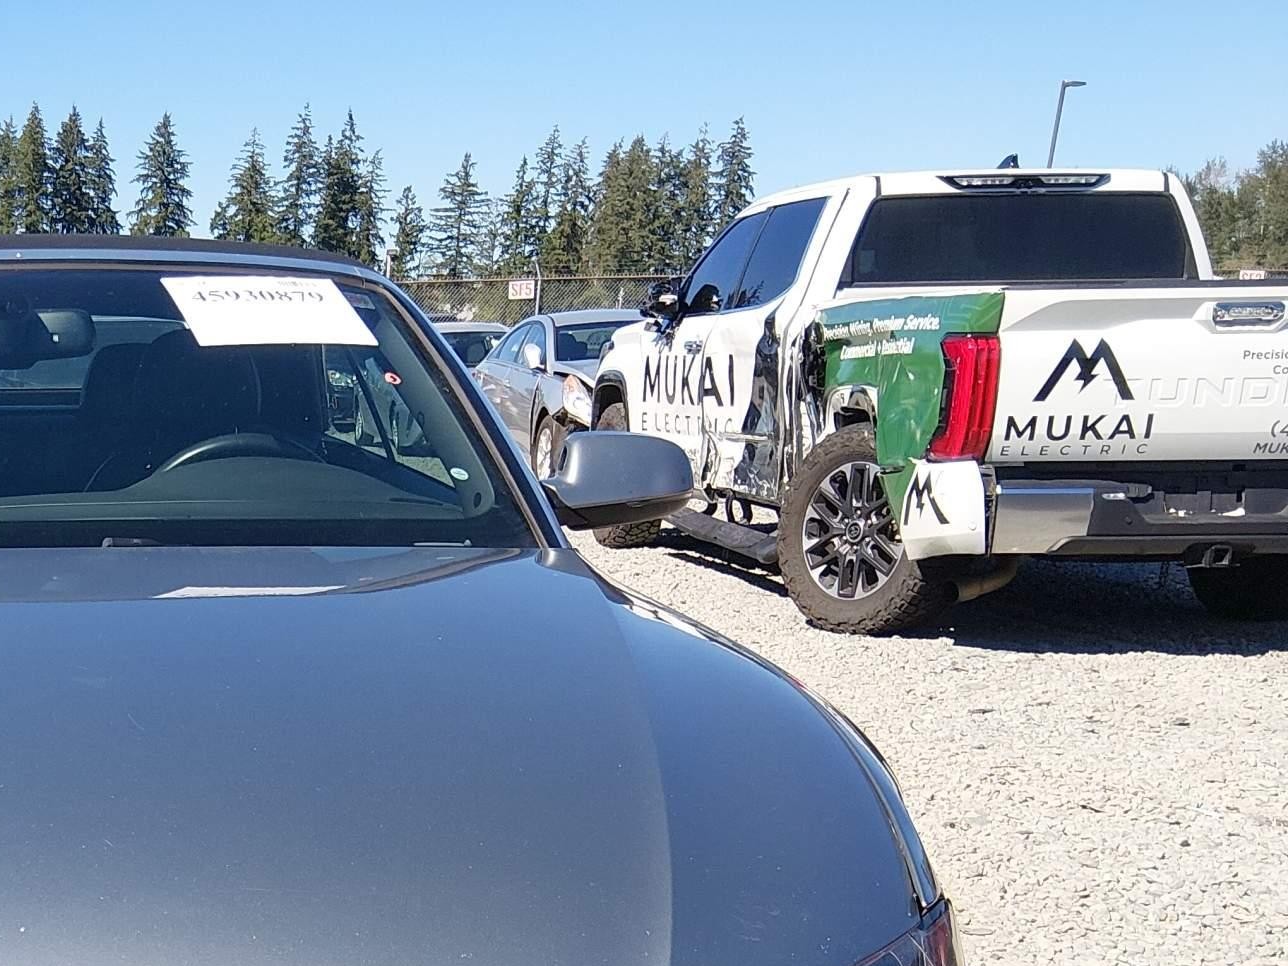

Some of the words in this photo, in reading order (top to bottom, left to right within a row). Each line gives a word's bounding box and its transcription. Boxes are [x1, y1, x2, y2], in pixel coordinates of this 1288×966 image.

[191, 288, 325, 303] 45930879
[511, 282, 533, 297] SF5
[904, 313, 941, 331] Service.
[642, 354, 734, 407] MUKAI
[1003, 413, 1154, 441] MUKAI
[999, 443, 1148, 456] ELECTRIC
